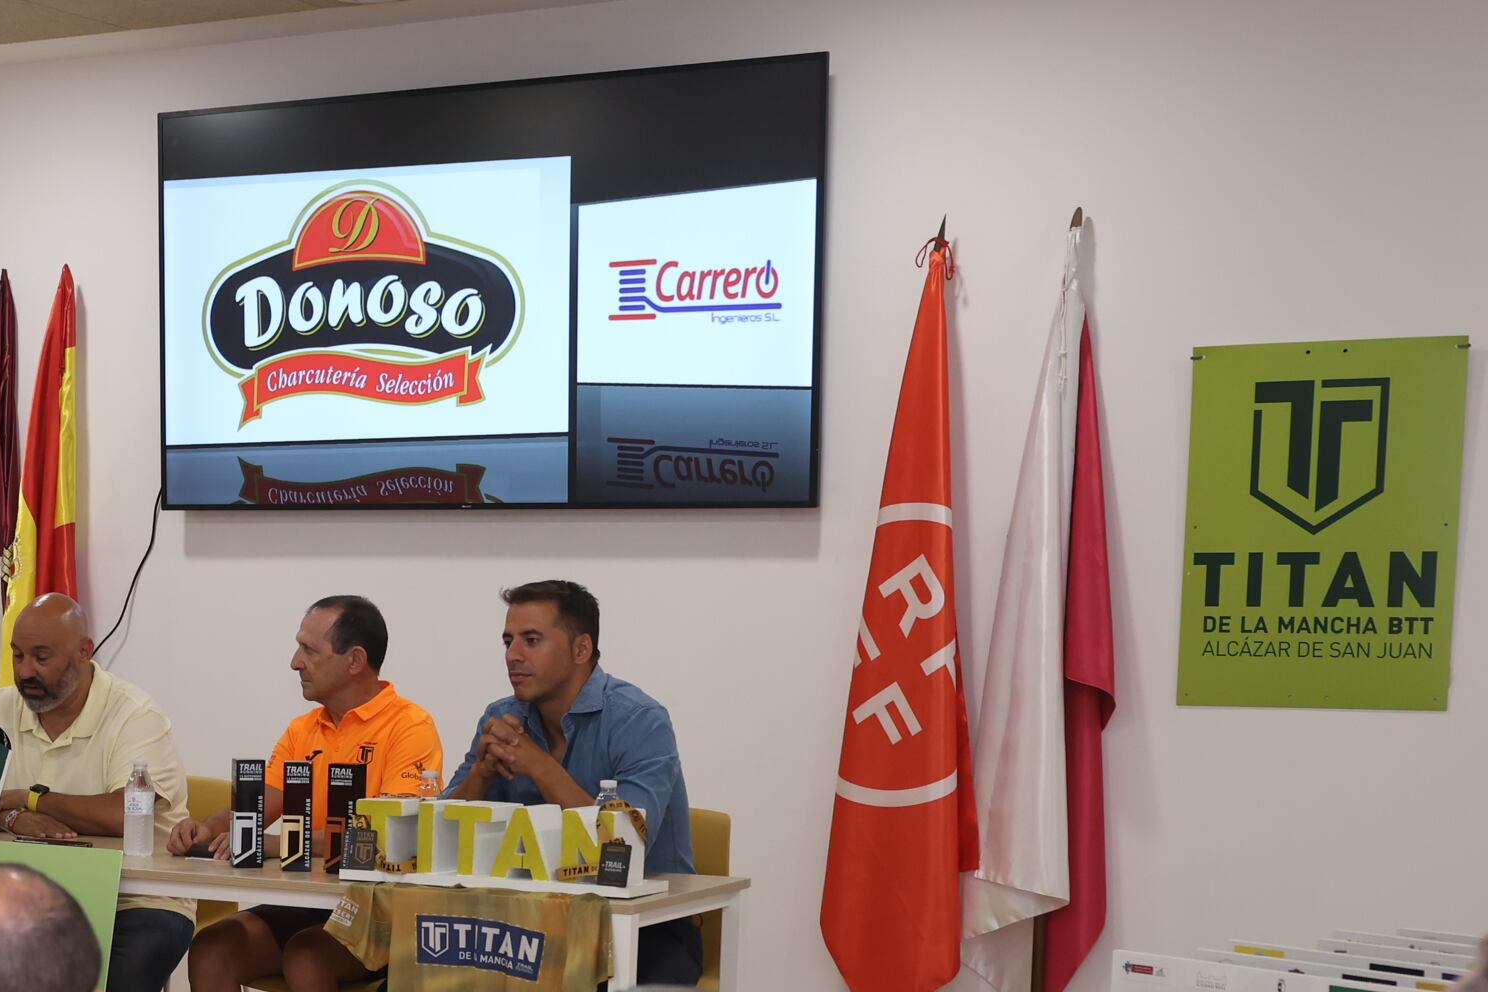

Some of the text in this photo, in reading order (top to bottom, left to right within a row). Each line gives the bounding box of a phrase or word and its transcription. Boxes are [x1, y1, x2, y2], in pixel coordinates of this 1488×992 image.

[655, 259, 779, 302] Carrero
[235, 274, 485, 350] Donoso
[266, 366, 455, 396] Charcutería Selección
[1193, 551, 1438, 608] TITAN
[1202, 616, 1434, 635] DE LA MANCHA BTT
[1202, 636, 1433, 660] ALCÁZAR DE SAN JUAN
[239, 763, 263, 771] TRAIL
[286, 765, 311, 774] TRAIL
[330, 767, 353, 776] TRAIL
[355, 799, 615, 882] TITAN
[563, 866, 589, 877] TITAN
[458, 951, 472, 960] DE
